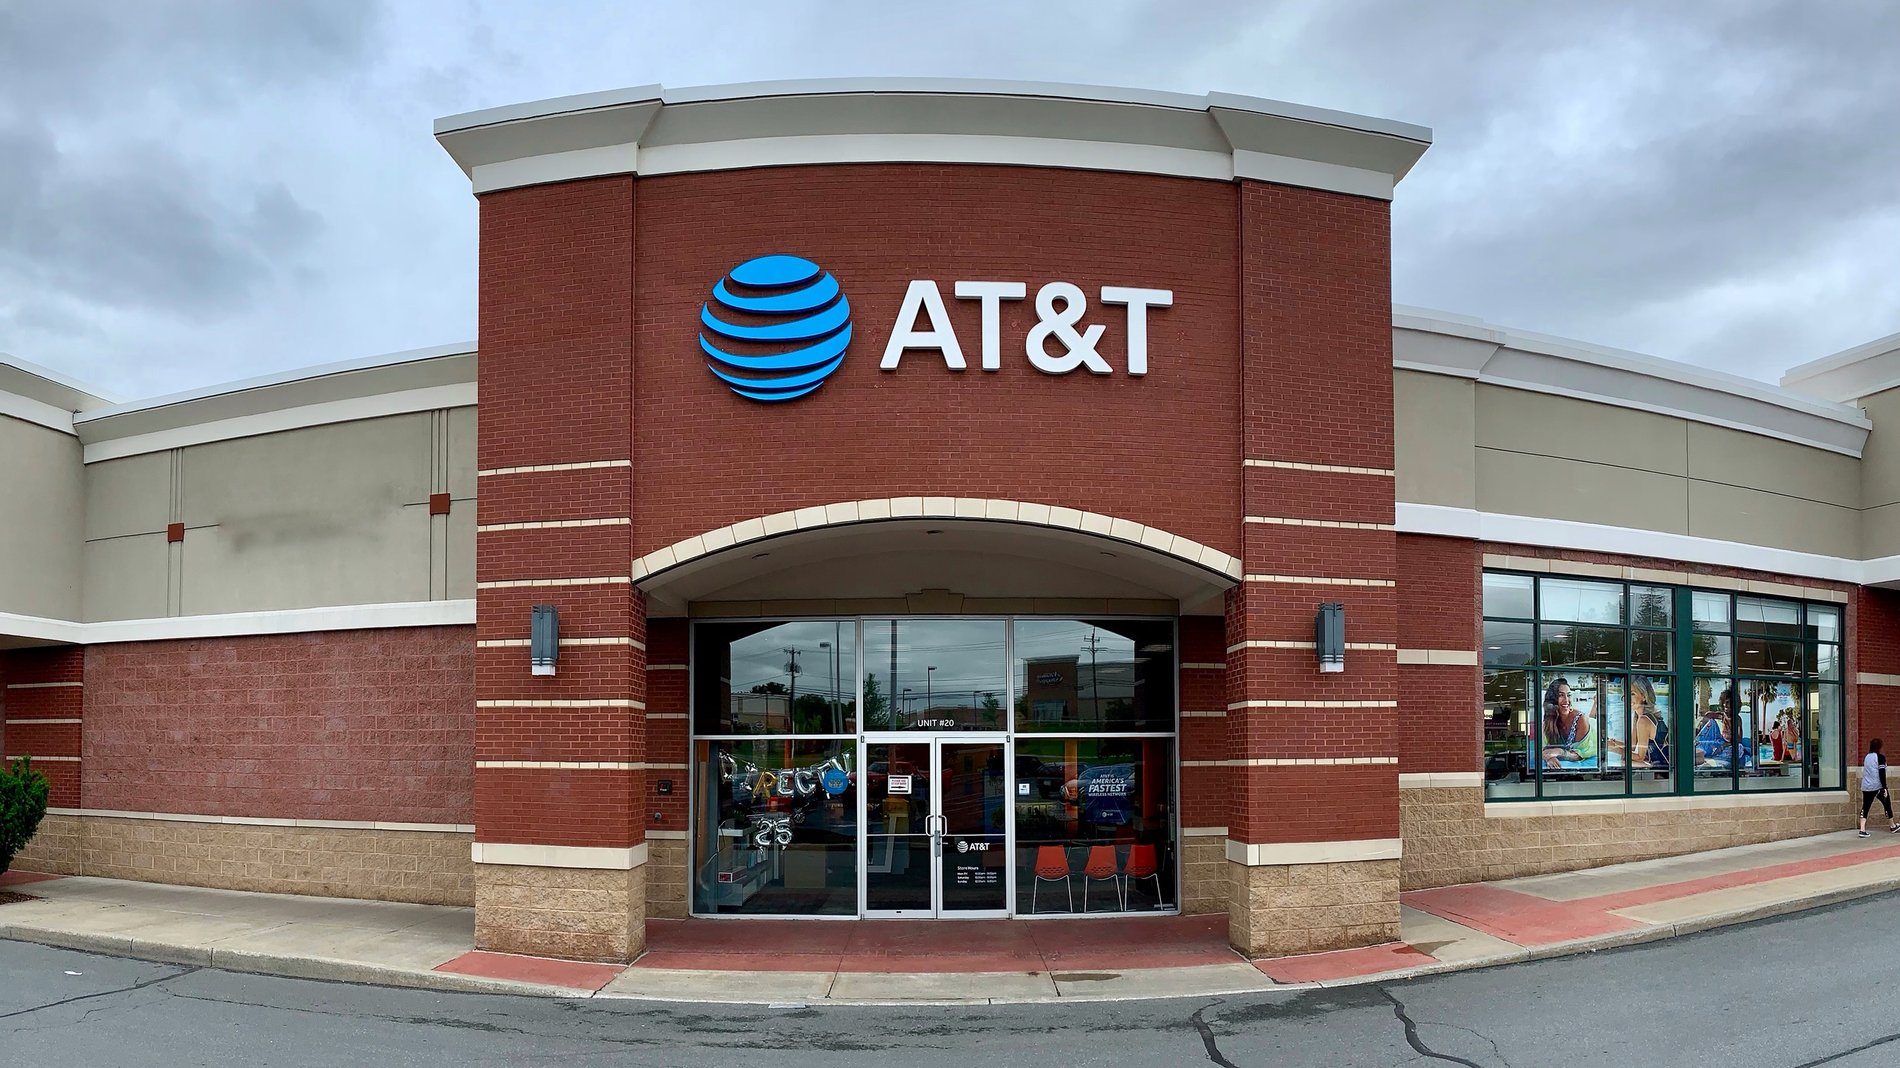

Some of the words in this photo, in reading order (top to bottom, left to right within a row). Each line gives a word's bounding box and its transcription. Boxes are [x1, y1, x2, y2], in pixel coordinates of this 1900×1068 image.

[879, 279, 1174, 377] AT&T
[917, 719, 937, 727] UNIT
[939, 719, 955, 727] #20
[1088, 784, 1127, 792] FASTEST
[969, 842, 990, 851] AT&T
